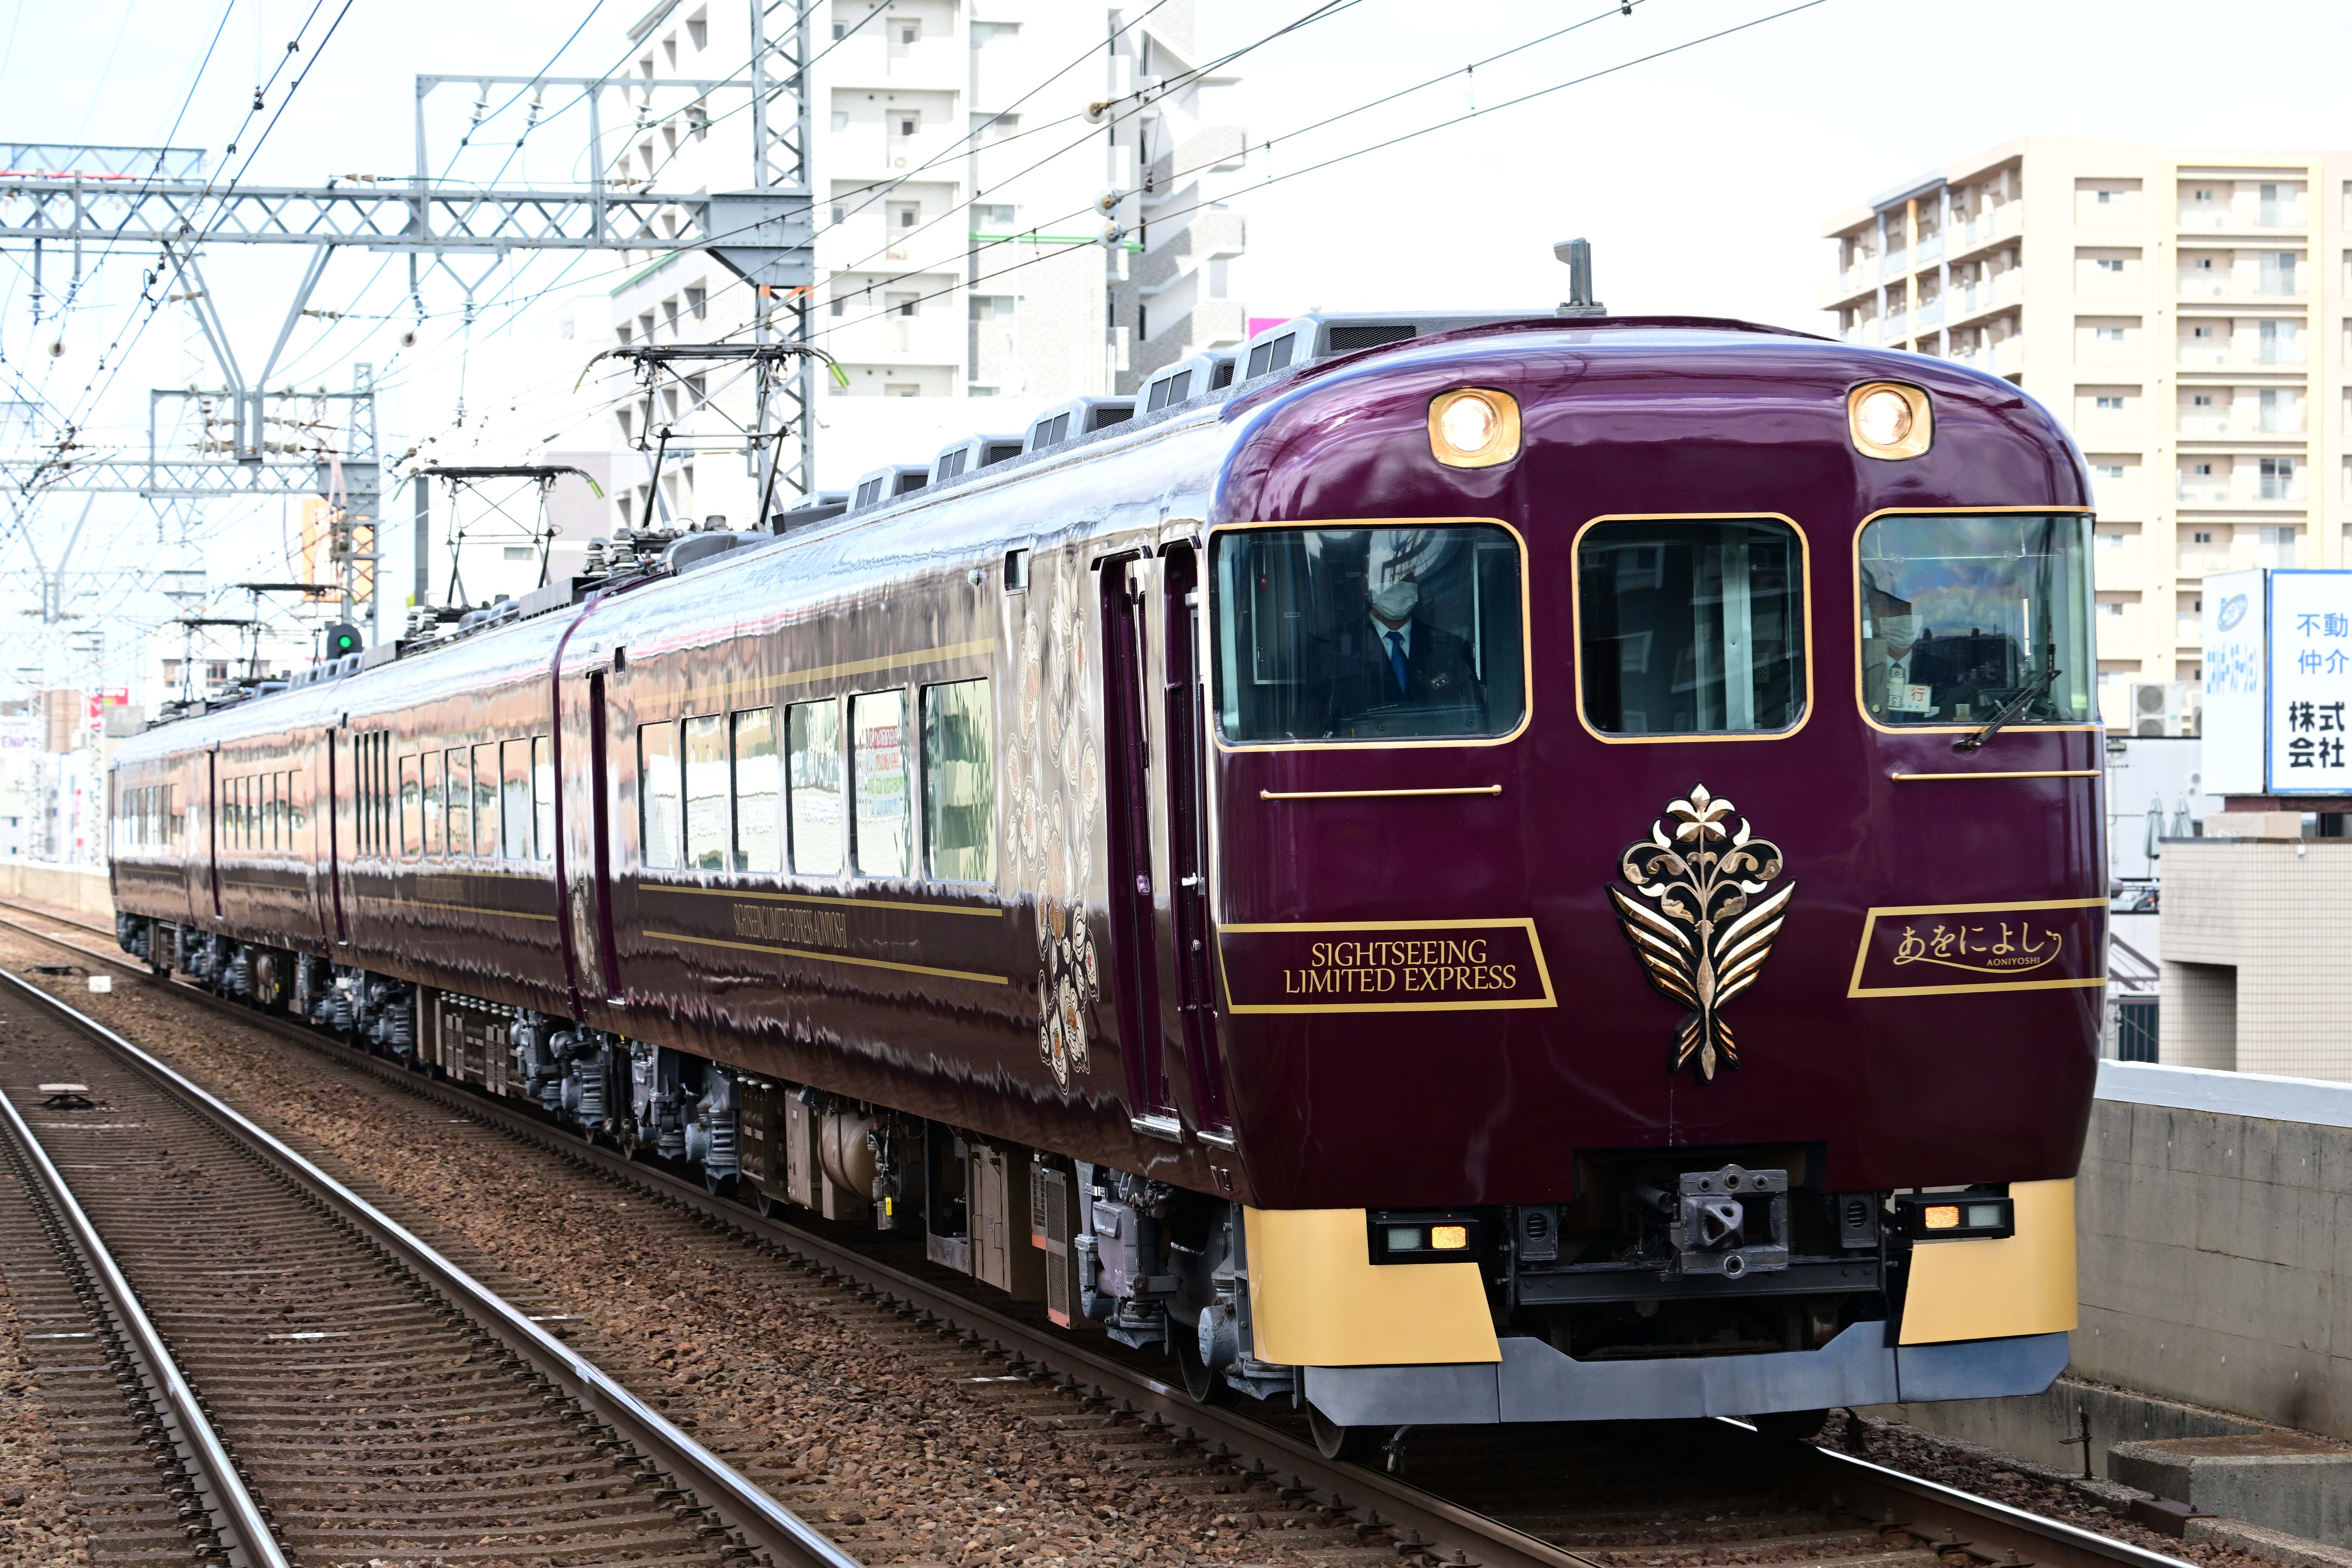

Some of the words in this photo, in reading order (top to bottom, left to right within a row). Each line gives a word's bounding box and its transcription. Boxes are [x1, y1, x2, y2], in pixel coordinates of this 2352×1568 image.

[2297, 613, 2352, 638] 不動
[2298, 648, 2350, 675] 仲介
[2288, 701, 2345, 732] 株式
[2288, 737, 2345, 768] 会社
[734, 903, 768, 939] SIGHTSEEING
[766, 906, 789, 942] LIMITED
[789, 908, 814, 945] EXPRESS
[814, 910, 847, 949] AONIYOSHI
[1311, 939, 1487, 967] SIGHTSEEING
[1893, 922, 2045, 965] あをによし
[1986, 956, 2041, 967] AONIYOSHI
[1283, 968, 1396, 994] LIMITED
[1404, 965, 1517, 991] EXPRESS
